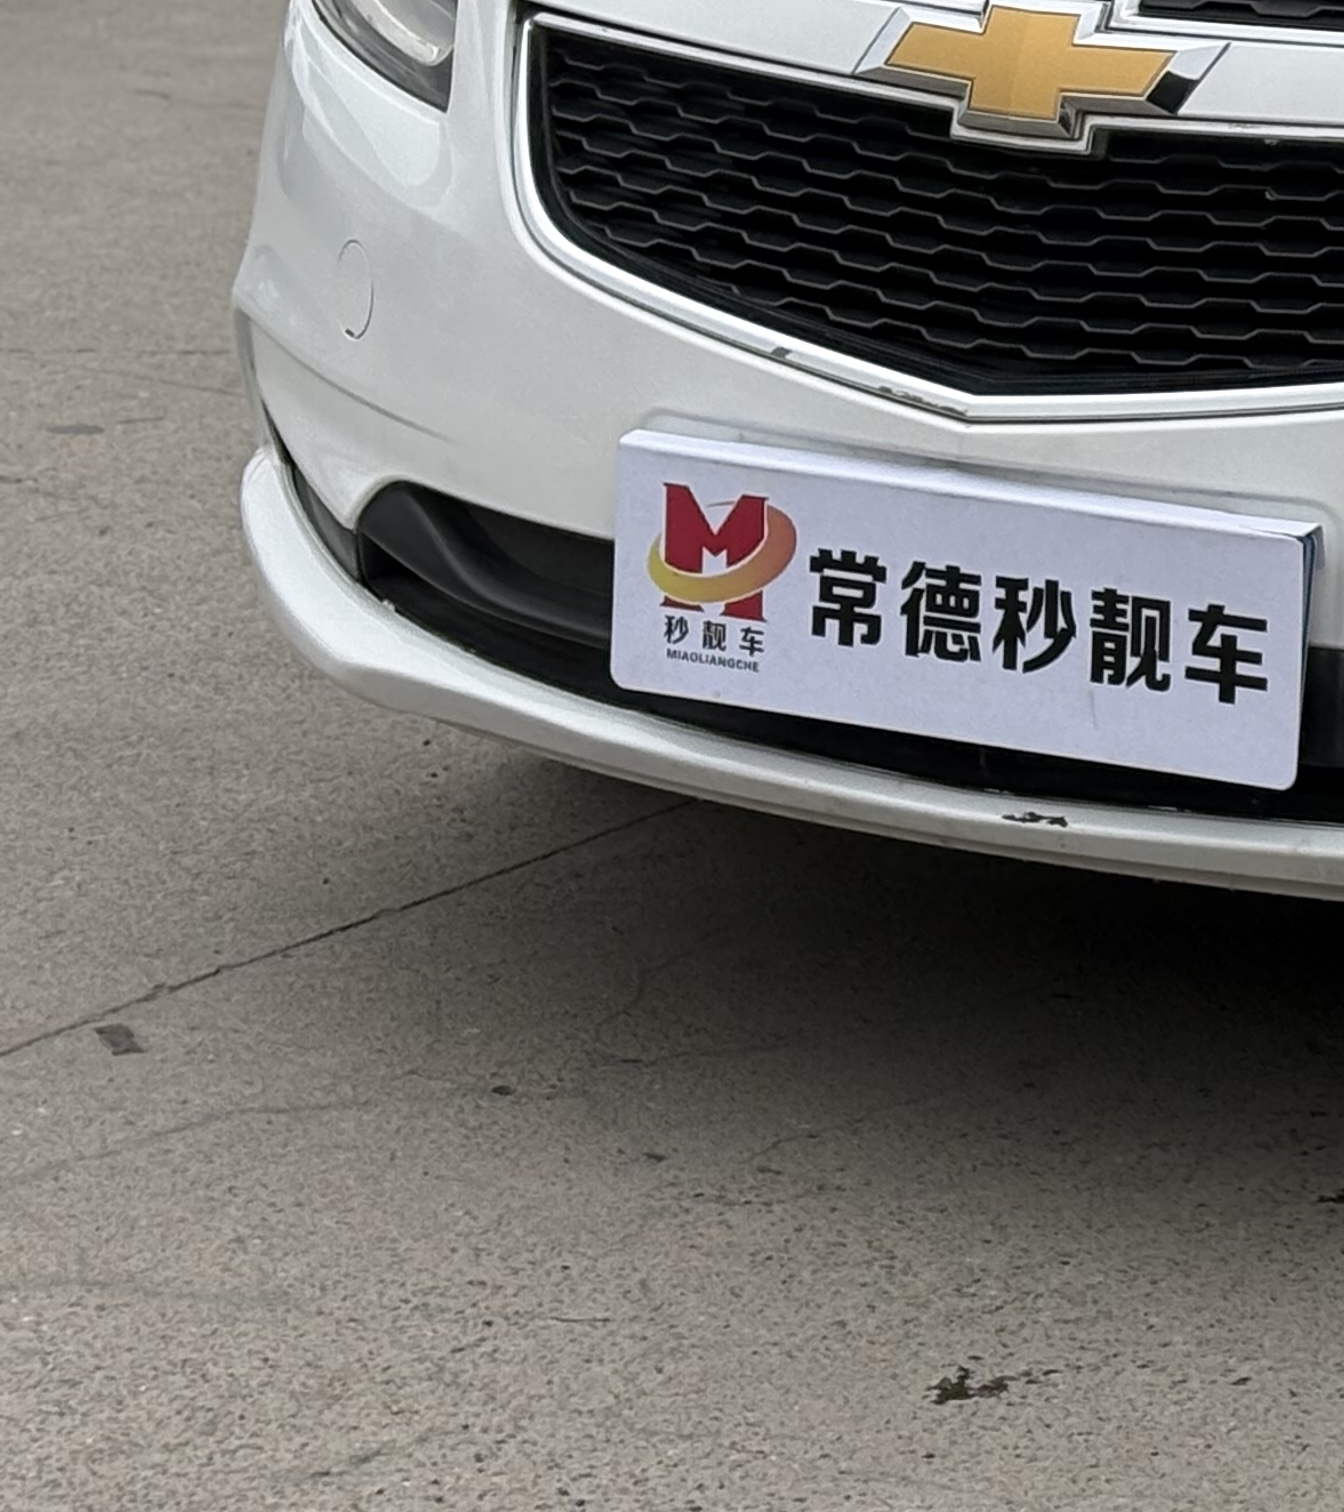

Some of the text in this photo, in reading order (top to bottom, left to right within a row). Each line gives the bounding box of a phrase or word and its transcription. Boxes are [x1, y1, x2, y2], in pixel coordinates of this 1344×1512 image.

[664, 615, 765, 657] 秒靓车
[809, 548, 1268, 704] 常德秒靓车
[666, 648, 760, 673] MIAOLIANGCHE
